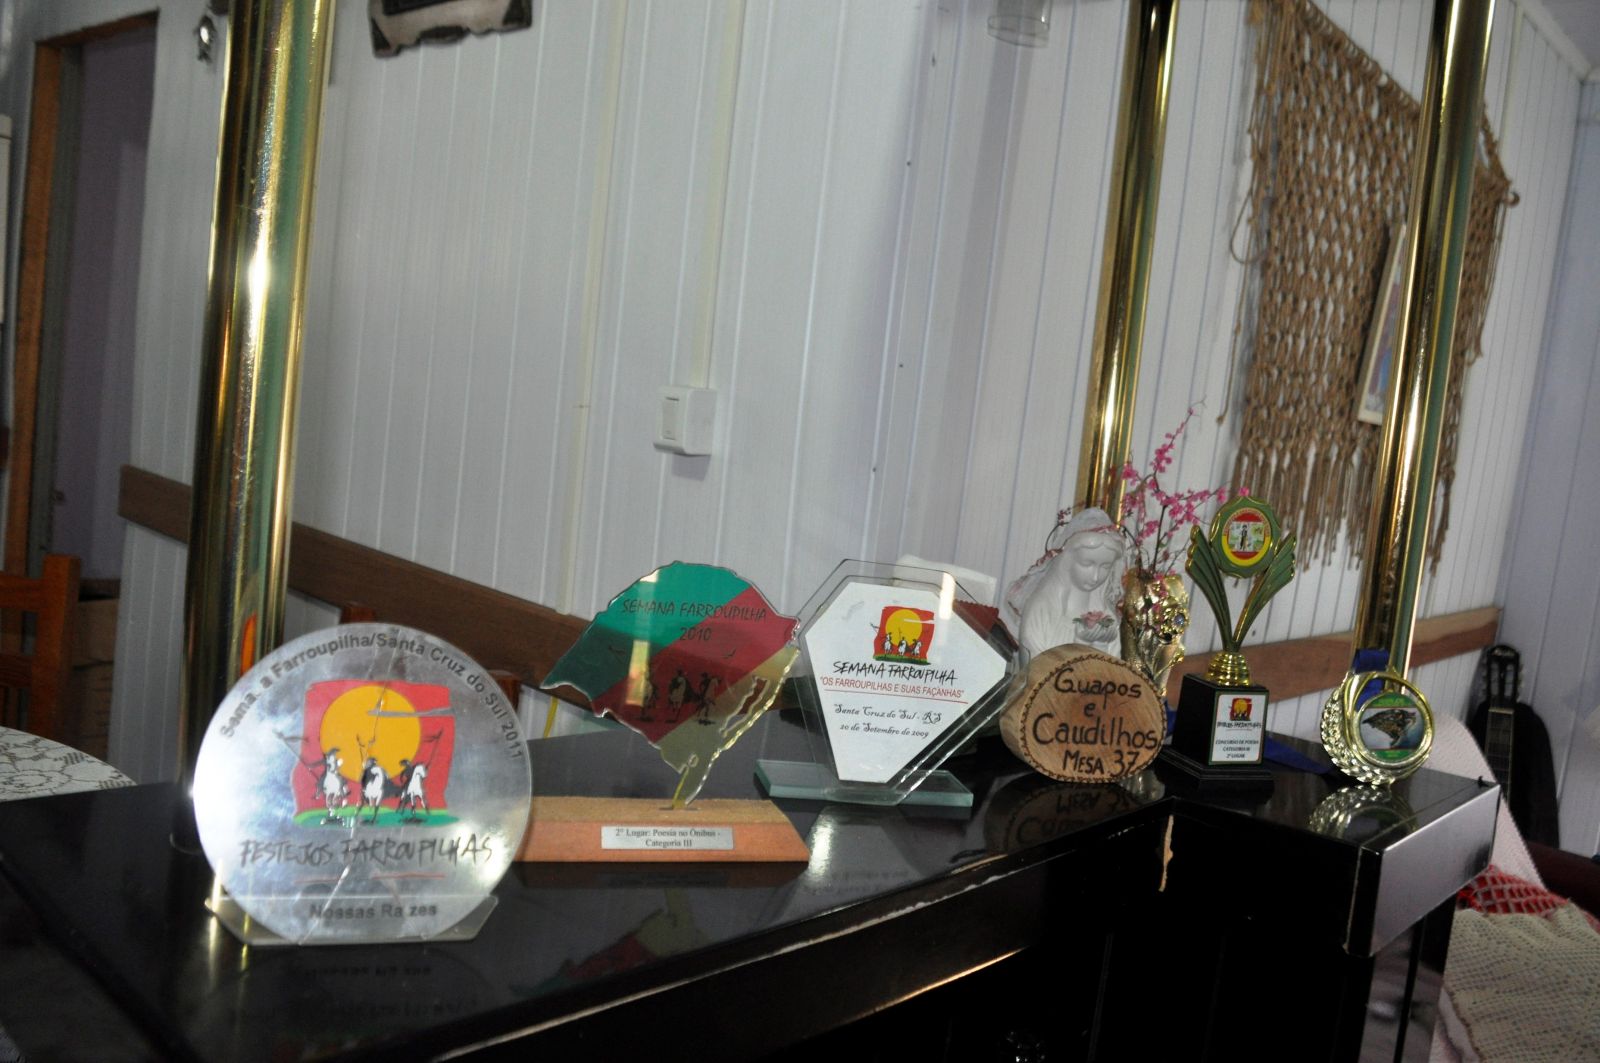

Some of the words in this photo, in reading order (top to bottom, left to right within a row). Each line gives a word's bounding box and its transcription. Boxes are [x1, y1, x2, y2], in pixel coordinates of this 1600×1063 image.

[621, 599, 676, 614] SEMANA
[679, 602, 768, 623] FARROUPILHA
[679, 627, 713, 641] 2010
[833, 661, 887, 680] SEMANA
[887, 664, 958, 687] FARROUPILHA
[835, 678, 893, 692] FARROUPILHAS
[894, 683, 899, 693] E
[901, 684, 921, 695] SUAS
[1054, 667, 1142, 710] Guapos
[220, 675, 273, 738] Semaa
[430, 646, 467, 677] Cruz
[466, 670, 486, 693] do
[485, 693, 509, 720] Sul
[501, 721, 524, 759] 2011
[1084, 702, 1096, 717] e
[834, 704, 860, 715] Santa
[863, 706, 886, 718] Cruz
[887, 710, 896, 718] do
[899, 709, 917, 720] Sul
[923, 710, 943, 724] RS
[851, 724, 860, 732] de
[863, 722, 900, 735] Setembro
[901, 727, 911, 736] de
[911, 730, 930, 740] 2009
[1032, 713, 1158, 750] Caudilhos
[1062, 750, 1105, 775] MESA
[1109, 751, 1140, 778] 37
[626, 828, 651, 838] Lugar:
[652, 828, 677, 837] Poesia
[238, 838, 334, 868] FESTEJOS
[341, 833, 494, 868] FARROUPILHAS
[645, 839, 681, 848] Categoria
[683, 839, 692, 847] III
[309, 903, 376, 920] Nossas
